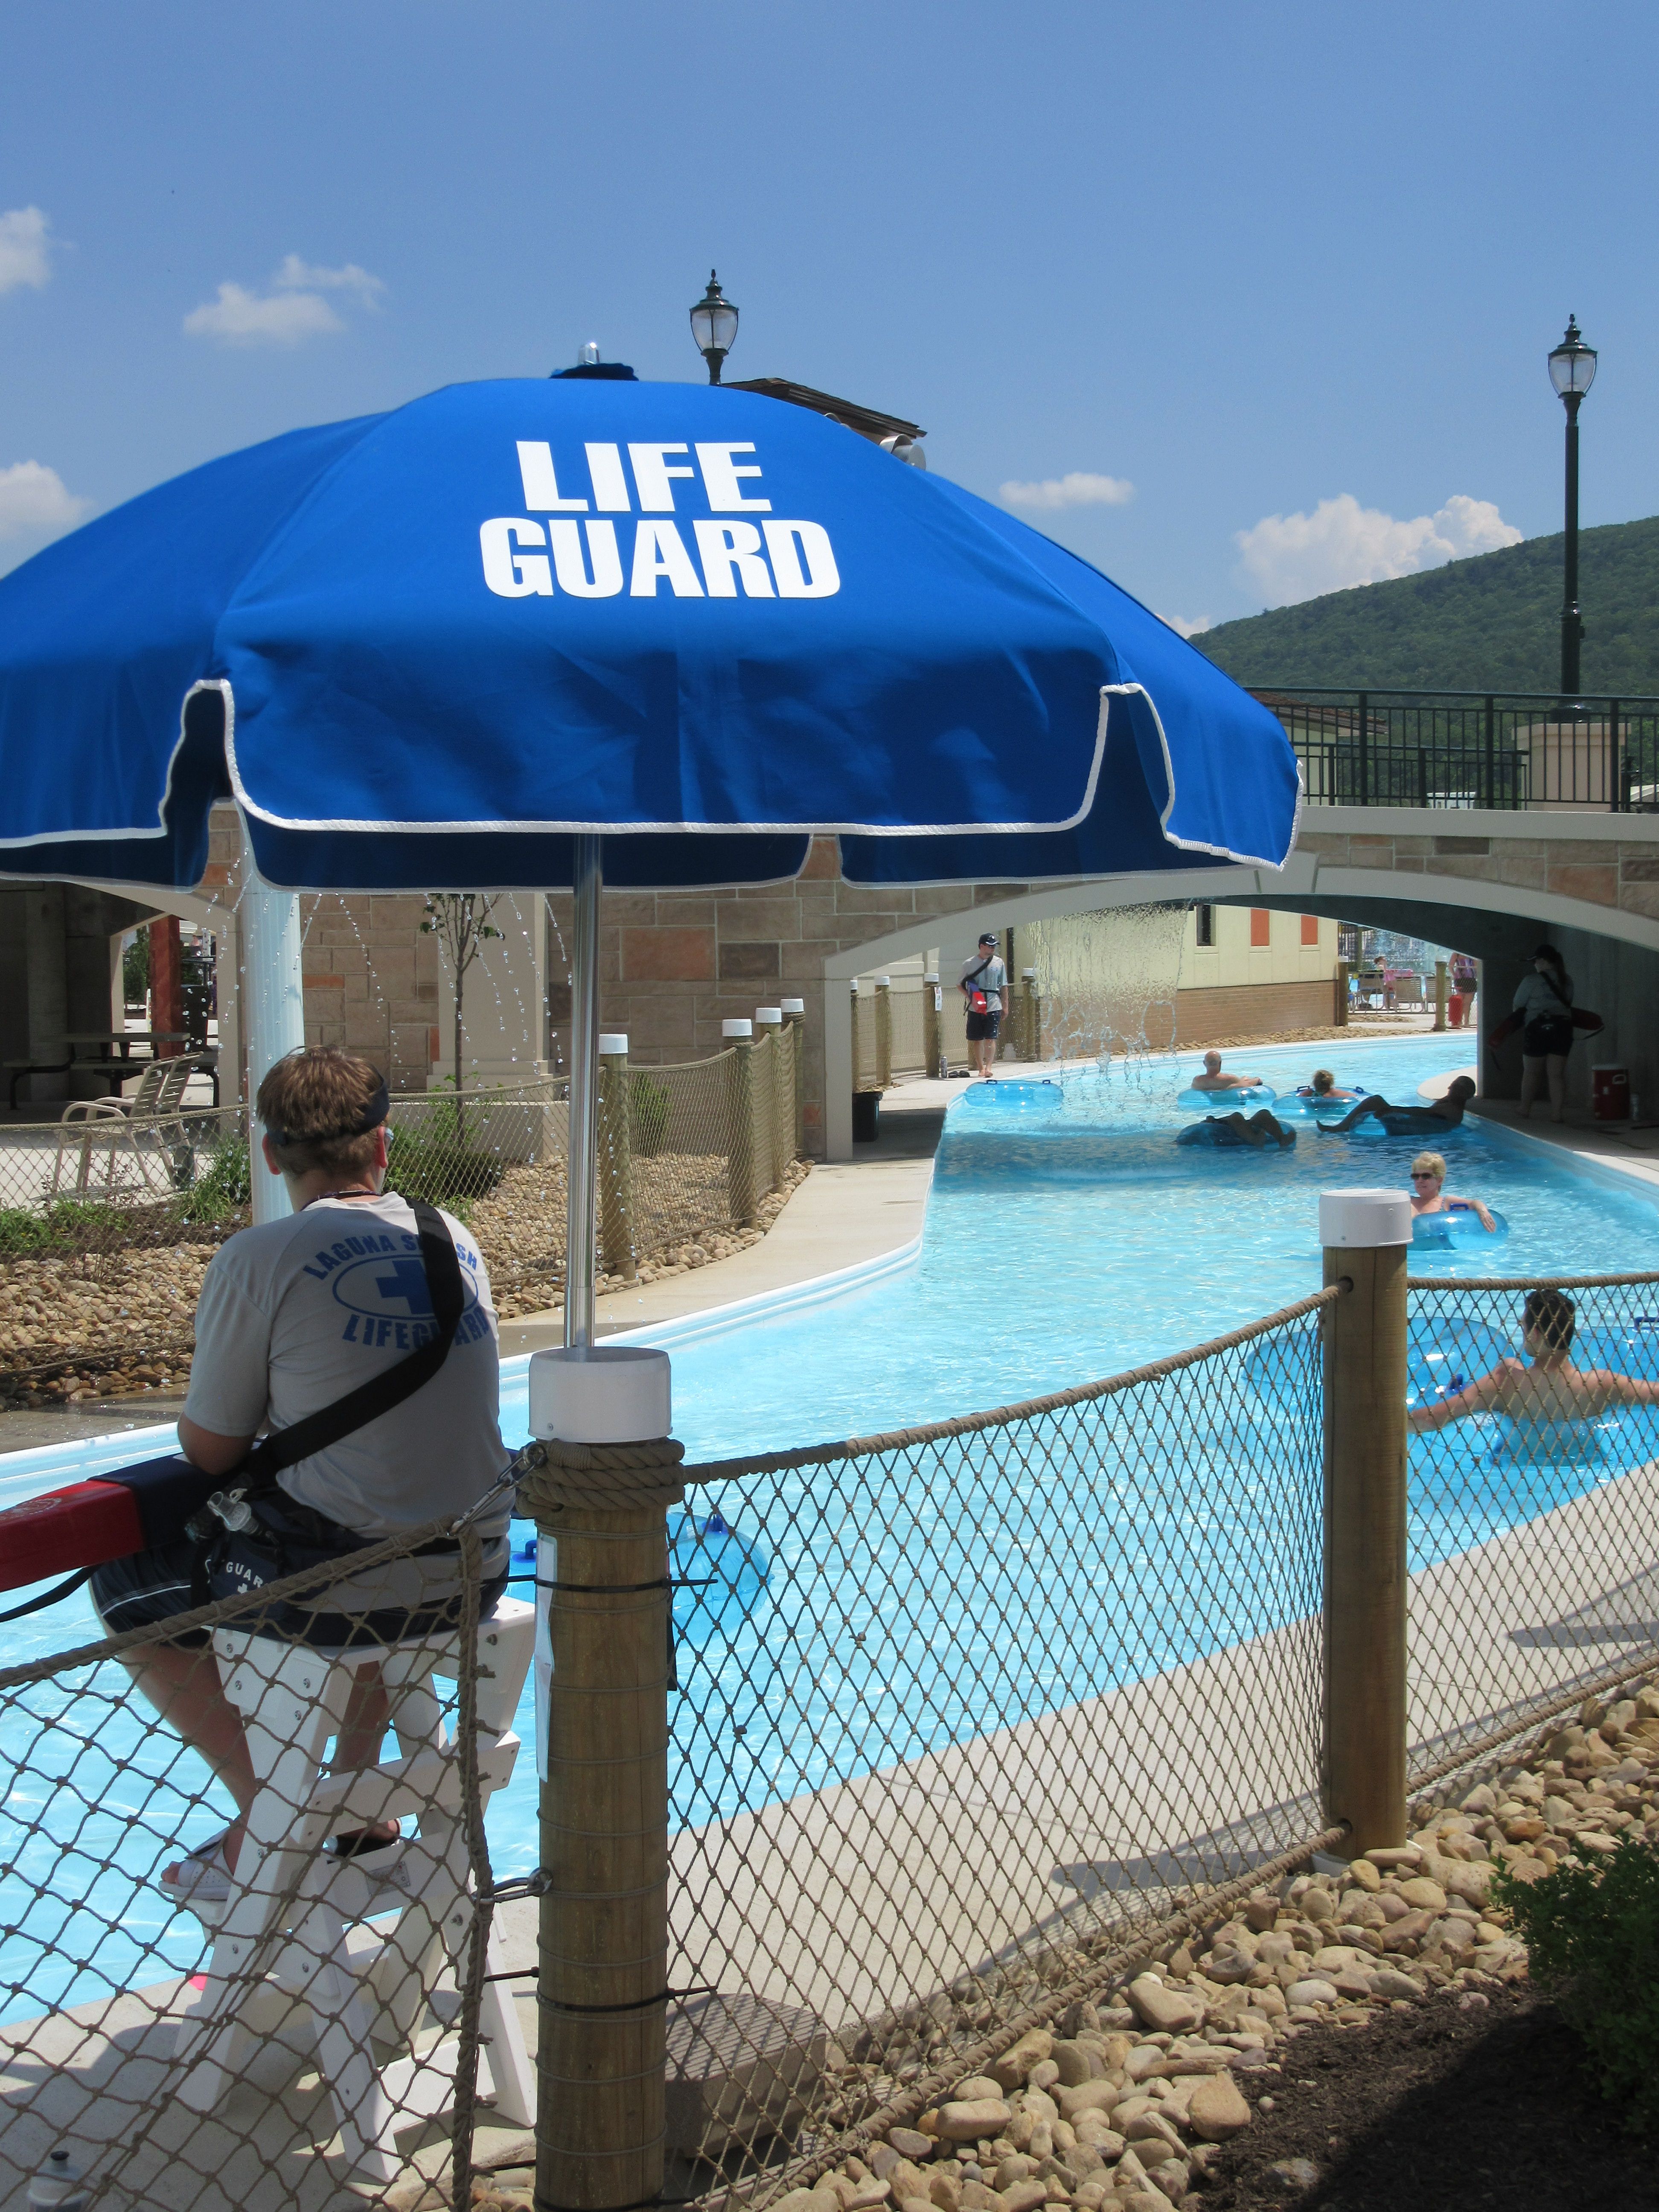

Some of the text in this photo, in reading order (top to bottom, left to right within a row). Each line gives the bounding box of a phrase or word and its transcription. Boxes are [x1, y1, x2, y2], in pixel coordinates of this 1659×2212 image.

[516, 441, 772, 511] LIFE
[480, 518, 841, 598] GUARD
[303, 1234, 477, 1280] LAGUNA SSH
[226, 1561, 264, 1588] GUAR
